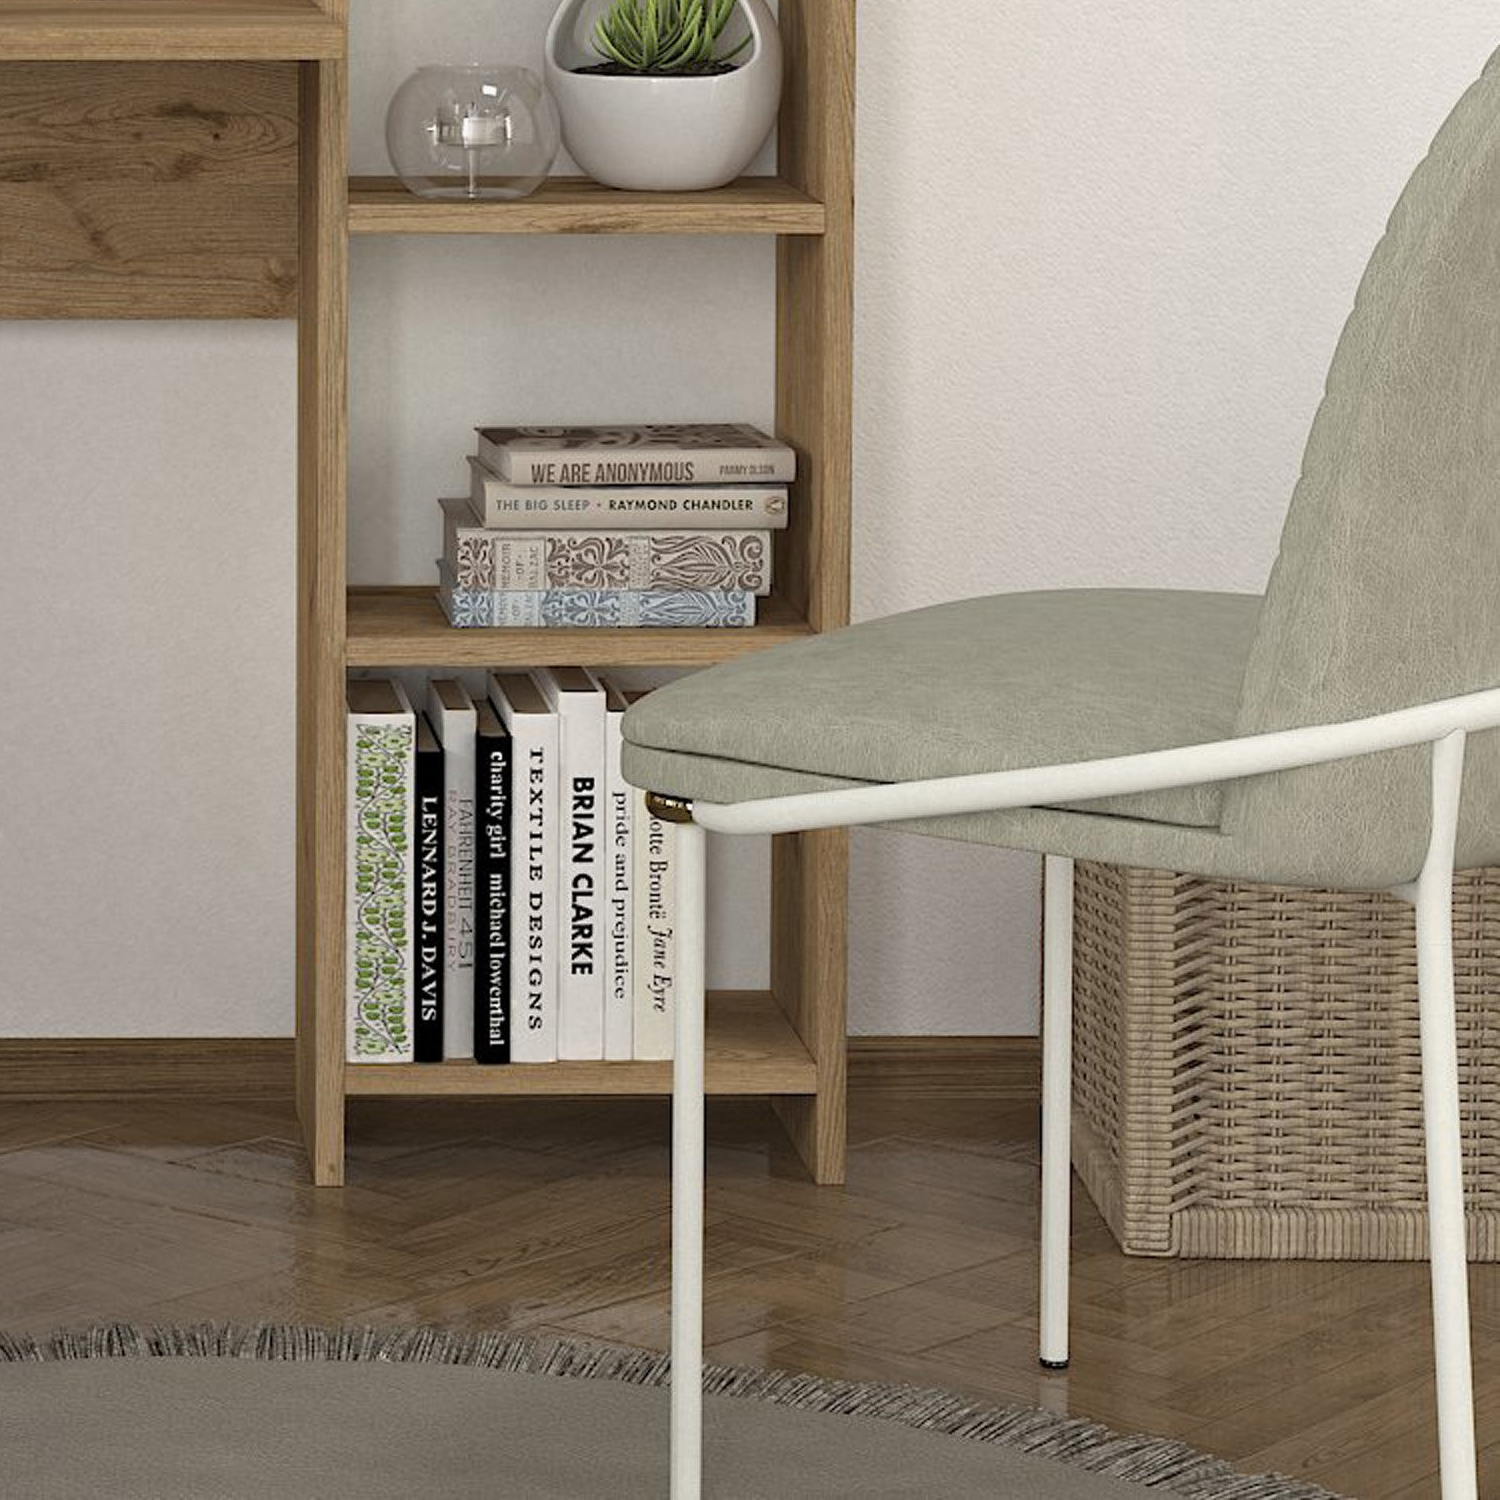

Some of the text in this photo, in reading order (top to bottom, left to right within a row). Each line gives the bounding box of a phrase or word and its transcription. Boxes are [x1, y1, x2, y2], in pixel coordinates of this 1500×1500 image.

[496, 499, 753, 511] THE BIG SLEEP RAYMOND CHANDLER
[531, 461, 695, 483] WE ARE ANONYMOUS
[421, 796, 436, 1020] LENNARD J. DAVIS
[458, 799, 472, 910] FAHRENHEIT
[485, 751, 505, 1045] charity girl michael lowenthal
[528, 747, 544, 1031] TEXTILE DESIGNS
[571, 776, 595, 975] BRIAN CLARKE
[611, 792, 628, 998] pride and prejudice
[649, 860, 668, 918] Brontë
[646, 973, 671, 1012] Eyre
[648, 927, 671, 968] Jane
